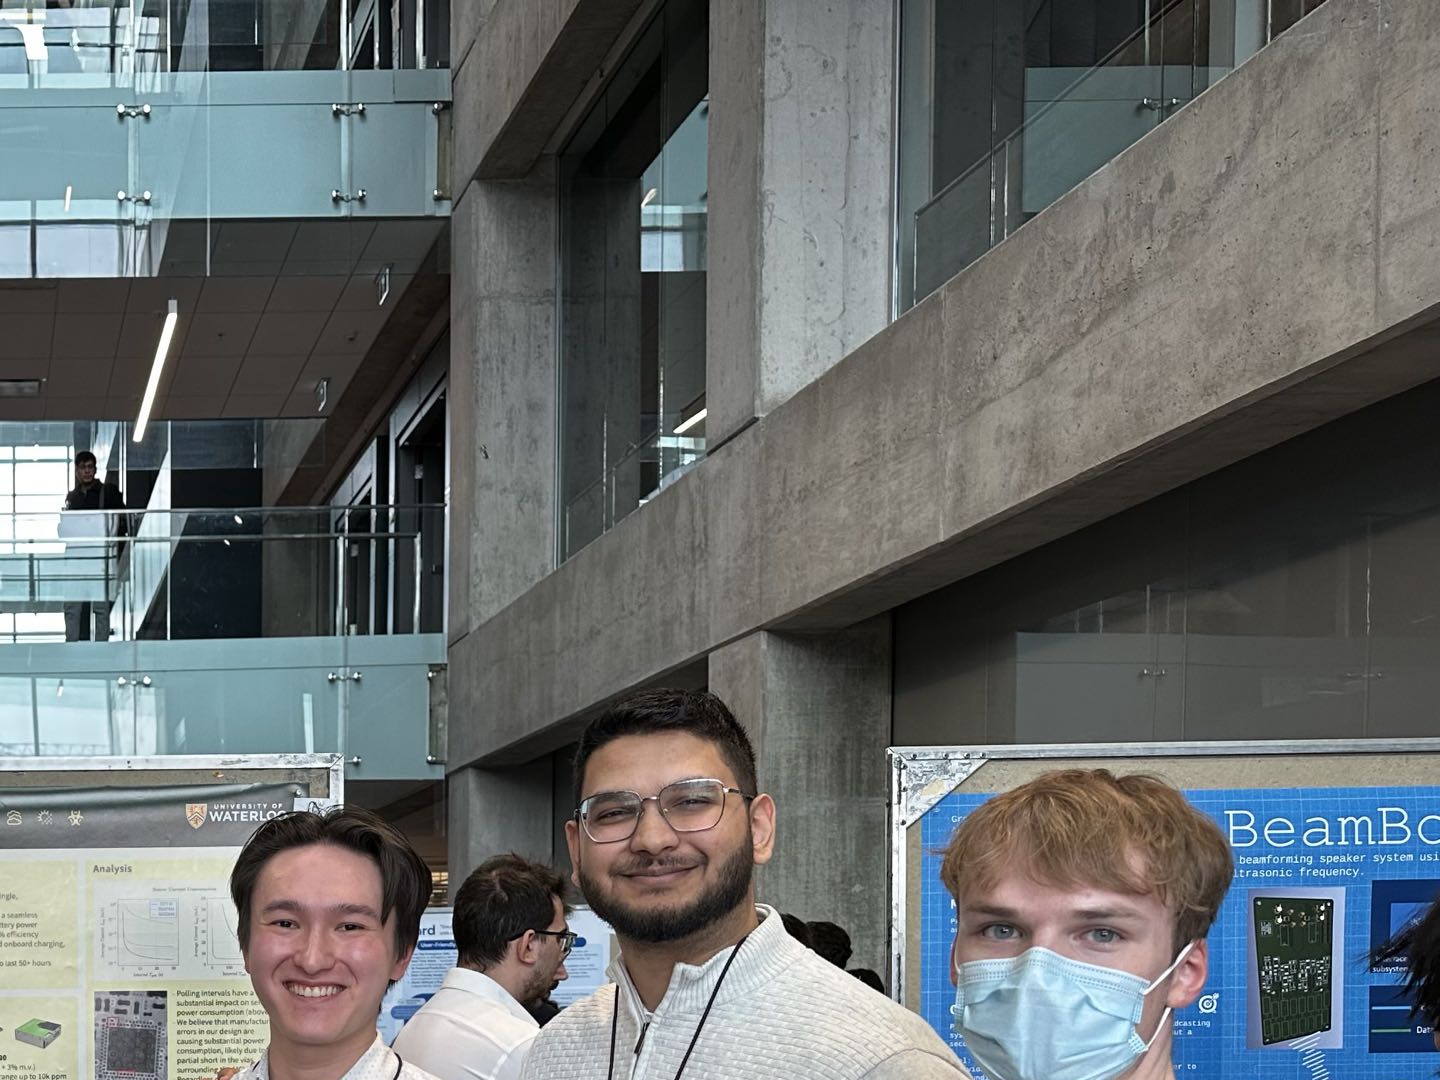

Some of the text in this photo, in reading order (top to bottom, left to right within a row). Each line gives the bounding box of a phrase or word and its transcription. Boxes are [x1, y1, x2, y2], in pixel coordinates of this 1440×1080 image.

[1240, 854, 1312, 865] beamforming
[1320, 854, 1365, 864] speaker
[1373, 854, 1413, 863] system
[93, 864, 132, 874] Analysis
[1234, 868, 1364, 878] ltrasonic frequency.
[177, 1038, 203, 1046] causing
